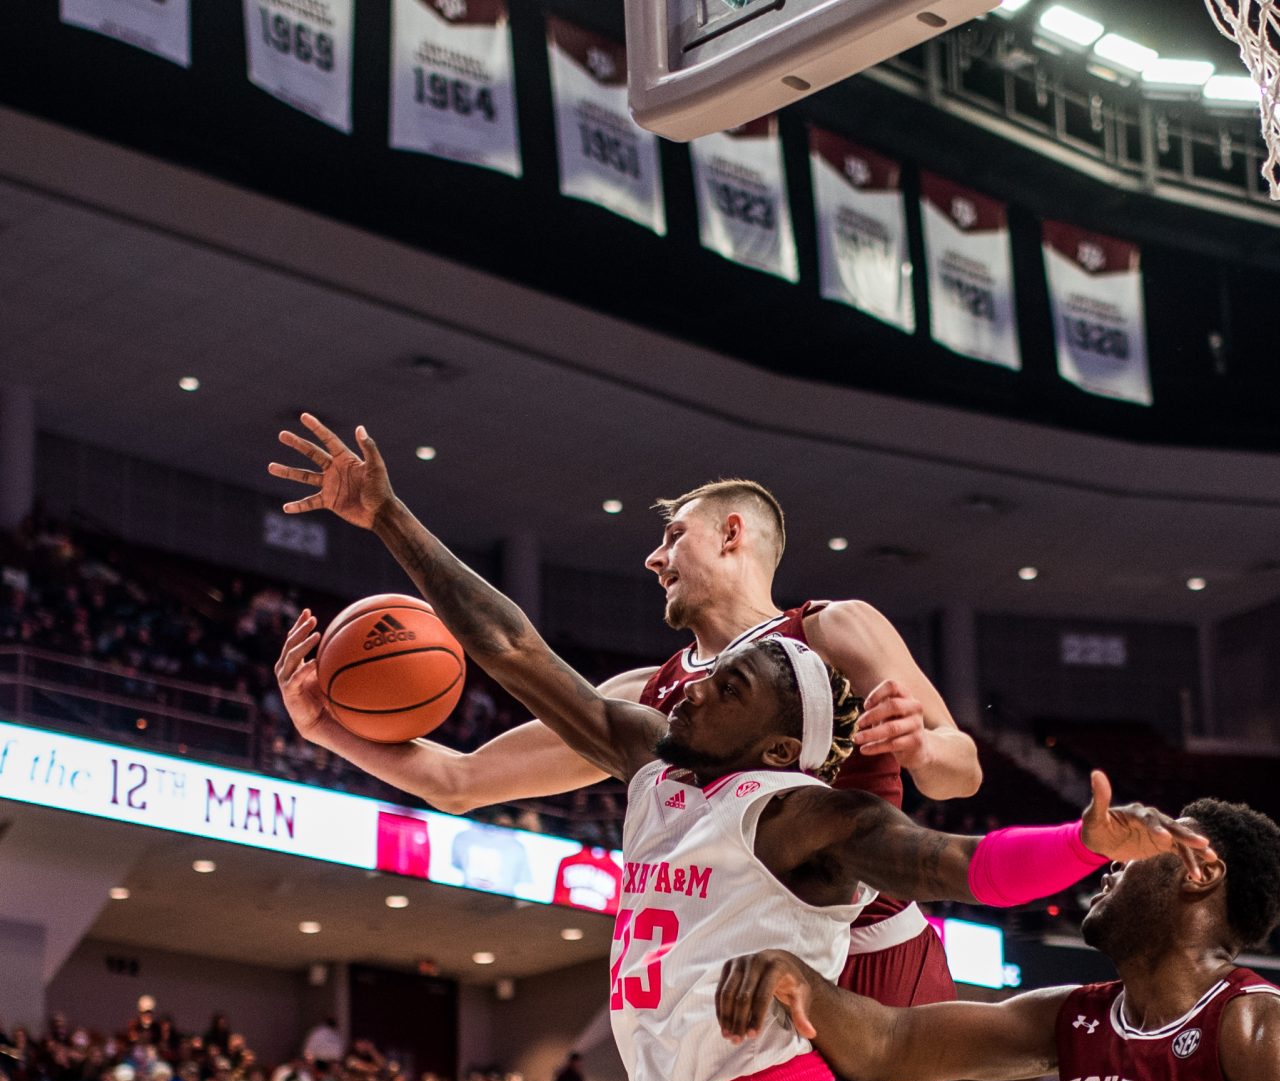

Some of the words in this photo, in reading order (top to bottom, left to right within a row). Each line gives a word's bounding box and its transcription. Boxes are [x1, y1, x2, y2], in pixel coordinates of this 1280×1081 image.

[259, 7, 334, 72] 1969
[413, 66, 496, 122] 1964
[363, 631, 416, 651] adidas
[205, 778, 297, 838] MAN
[654, 861, 712, 899] A&M
[1174, 1030, 1201, 1056] SEC
